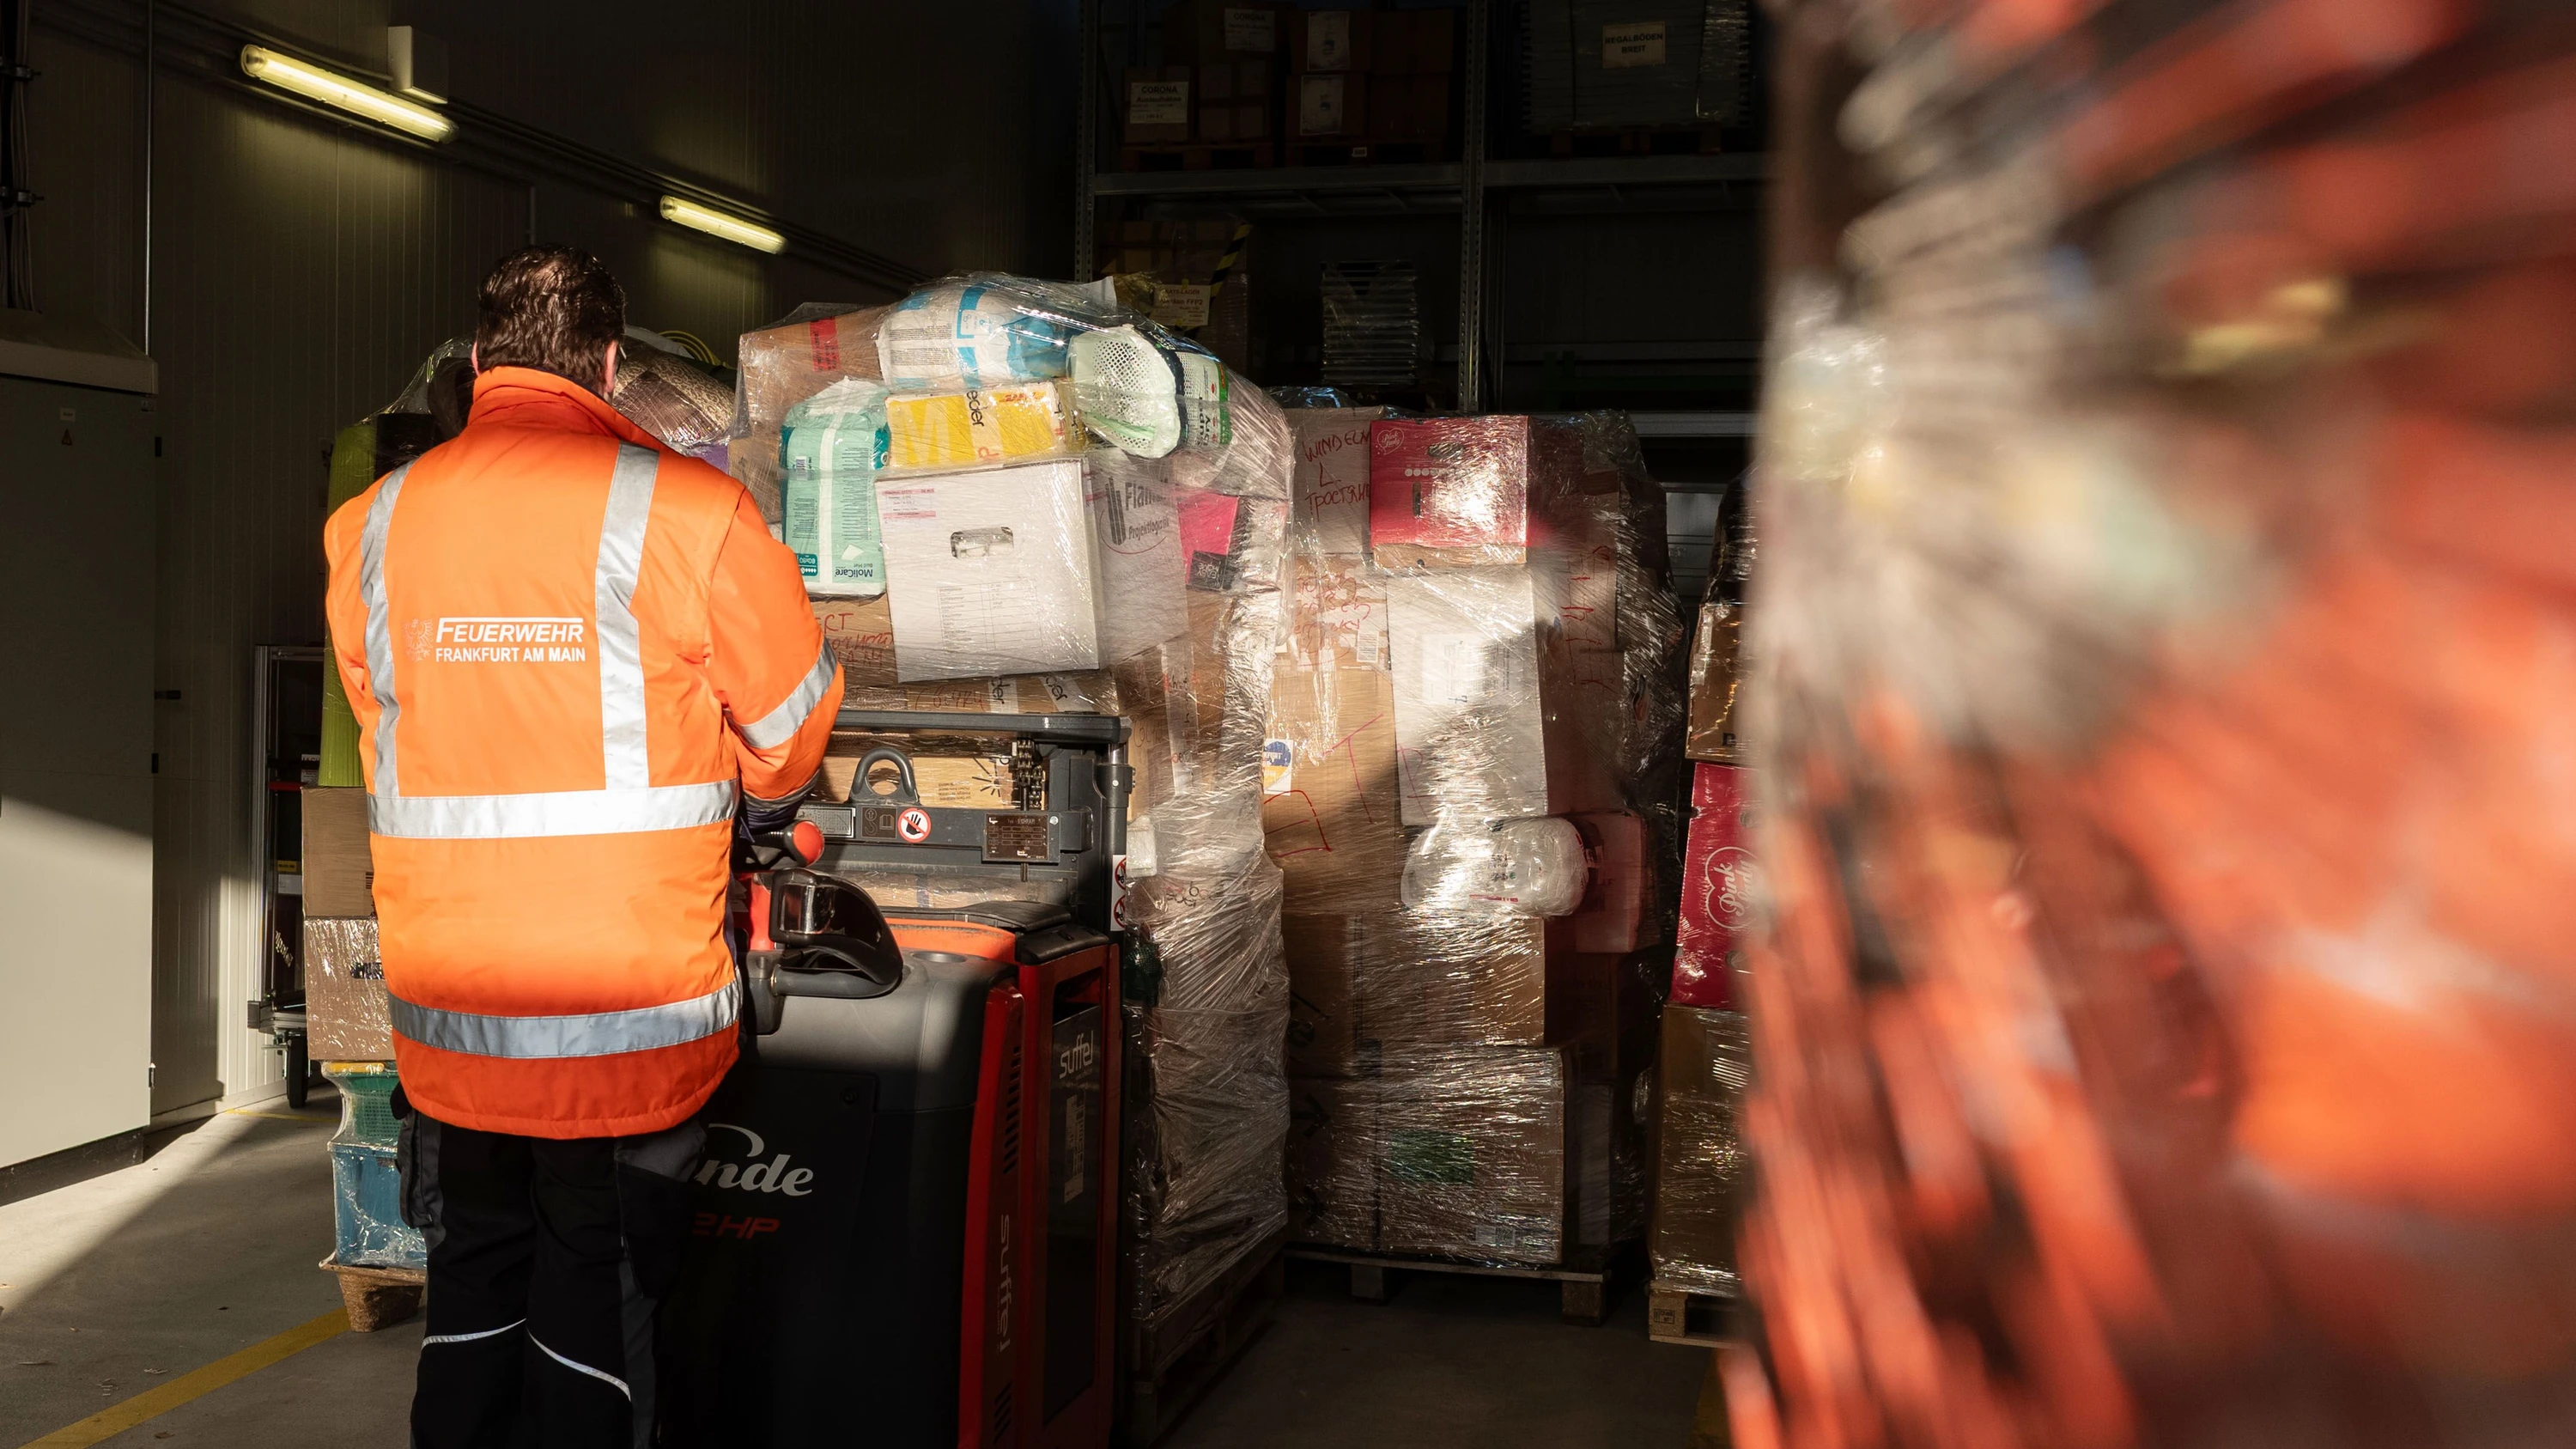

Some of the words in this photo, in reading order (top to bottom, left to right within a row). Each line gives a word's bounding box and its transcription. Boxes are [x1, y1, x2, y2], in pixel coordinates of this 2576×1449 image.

[1604, 33, 1663, 45] REGALBÖDEN
[1621, 45, 1646, 53] BREIT
[835, 569, 873, 578] MoliCare
[435, 617, 584, 643] FEUERWEHR
[435, 647, 519, 662] FRANKFURT
[522, 647, 544, 662] AM
[548, 647, 586, 662] MAIN
[1710, 861, 1746, 917] Pink
[1059, 1029, 1094, 1080] suffel
[692, 1123, 814, 1197] nde
[999, 1213, 1013, 1354] suffel
